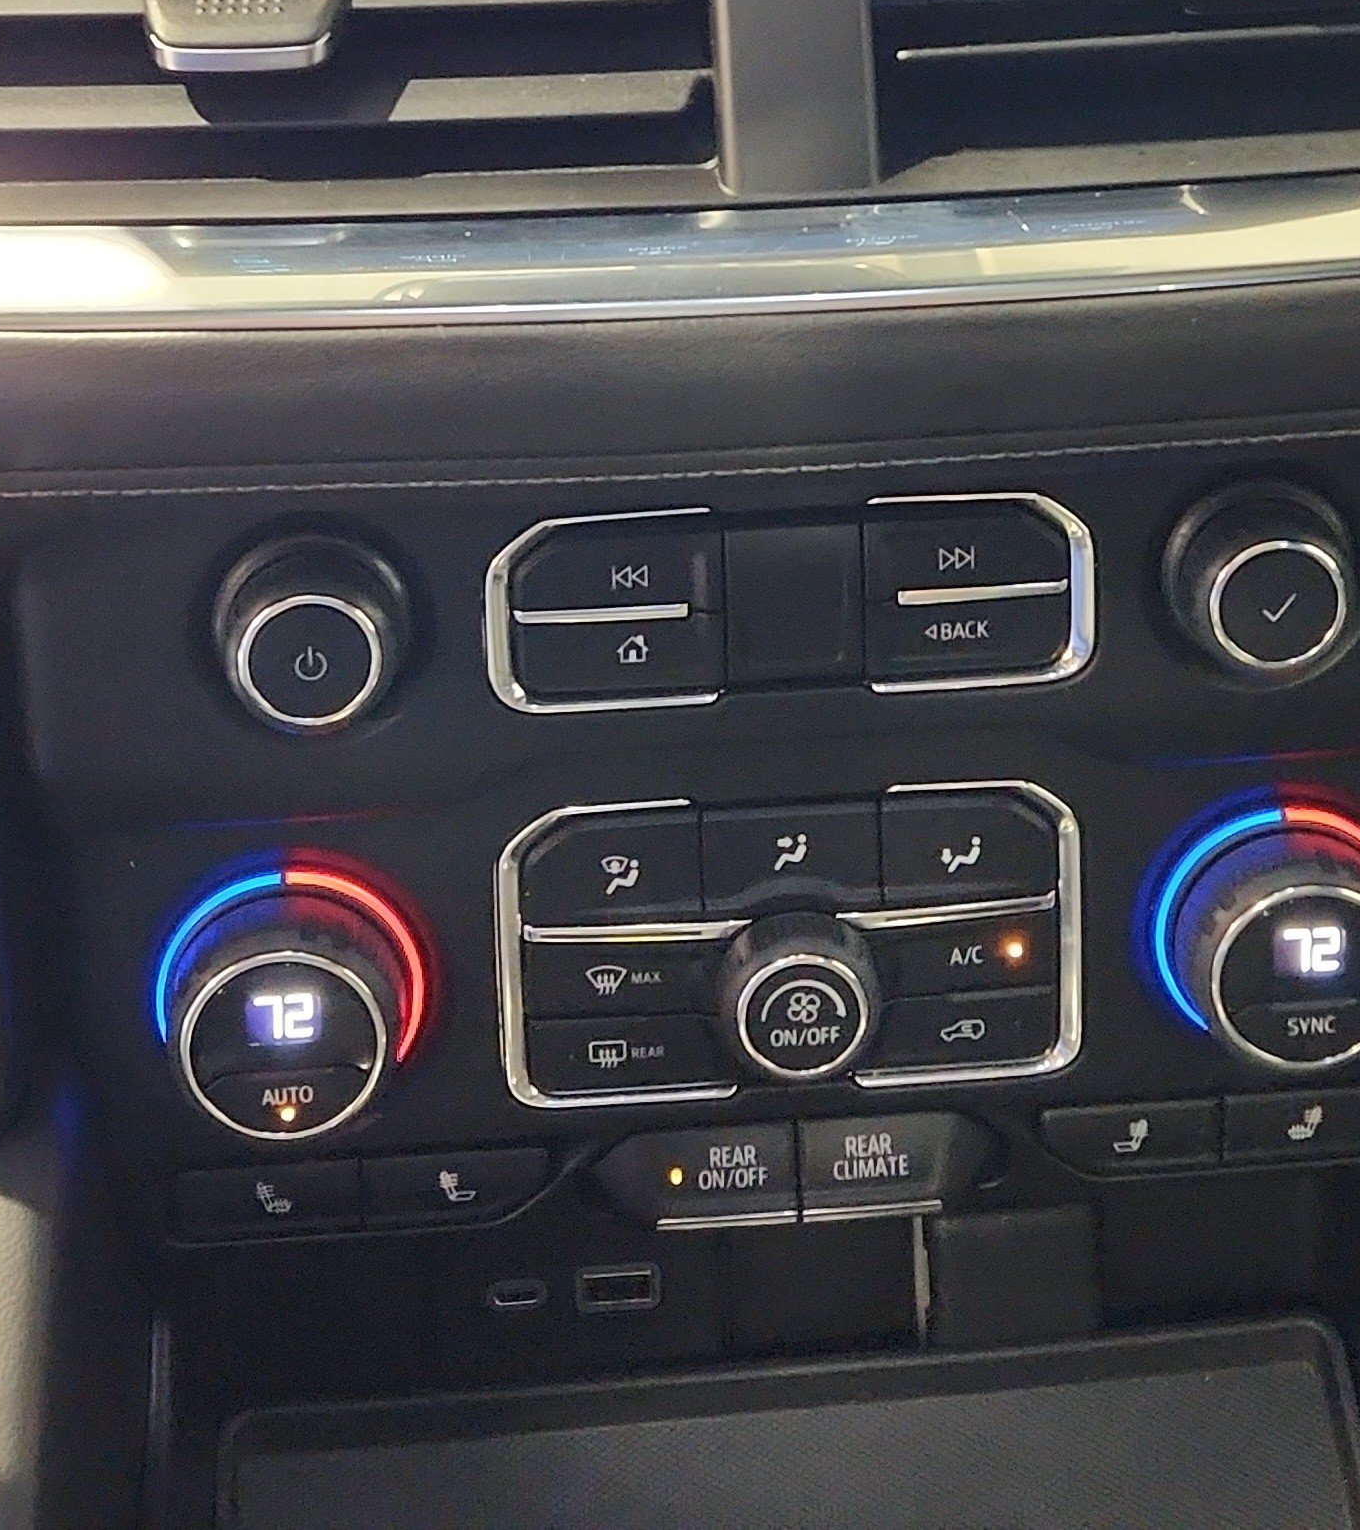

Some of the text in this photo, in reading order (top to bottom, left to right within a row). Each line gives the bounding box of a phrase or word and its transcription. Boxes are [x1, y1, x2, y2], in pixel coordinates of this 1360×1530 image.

[940, 619, 990, 642] BACK
[949, 944, 984, 967] A/C
[1282, 926, 1341, 974] 72
[252, 992, 314, 1040] 72
[1286, 1014, 1337, 1037] SYNC
[769, 1025, 840, 1050] ON/OFF
[630, 1044, 666, 1060] REAR
[261, 1085, 314, 1107] AUTO
[708, 1145, 757, 1167] REAR
[844, 1134, 892, 1159] REAR
[698, 1166, 769, 1189] ON/OFF
[833, 1155, 910, 1180] CLIMATE
